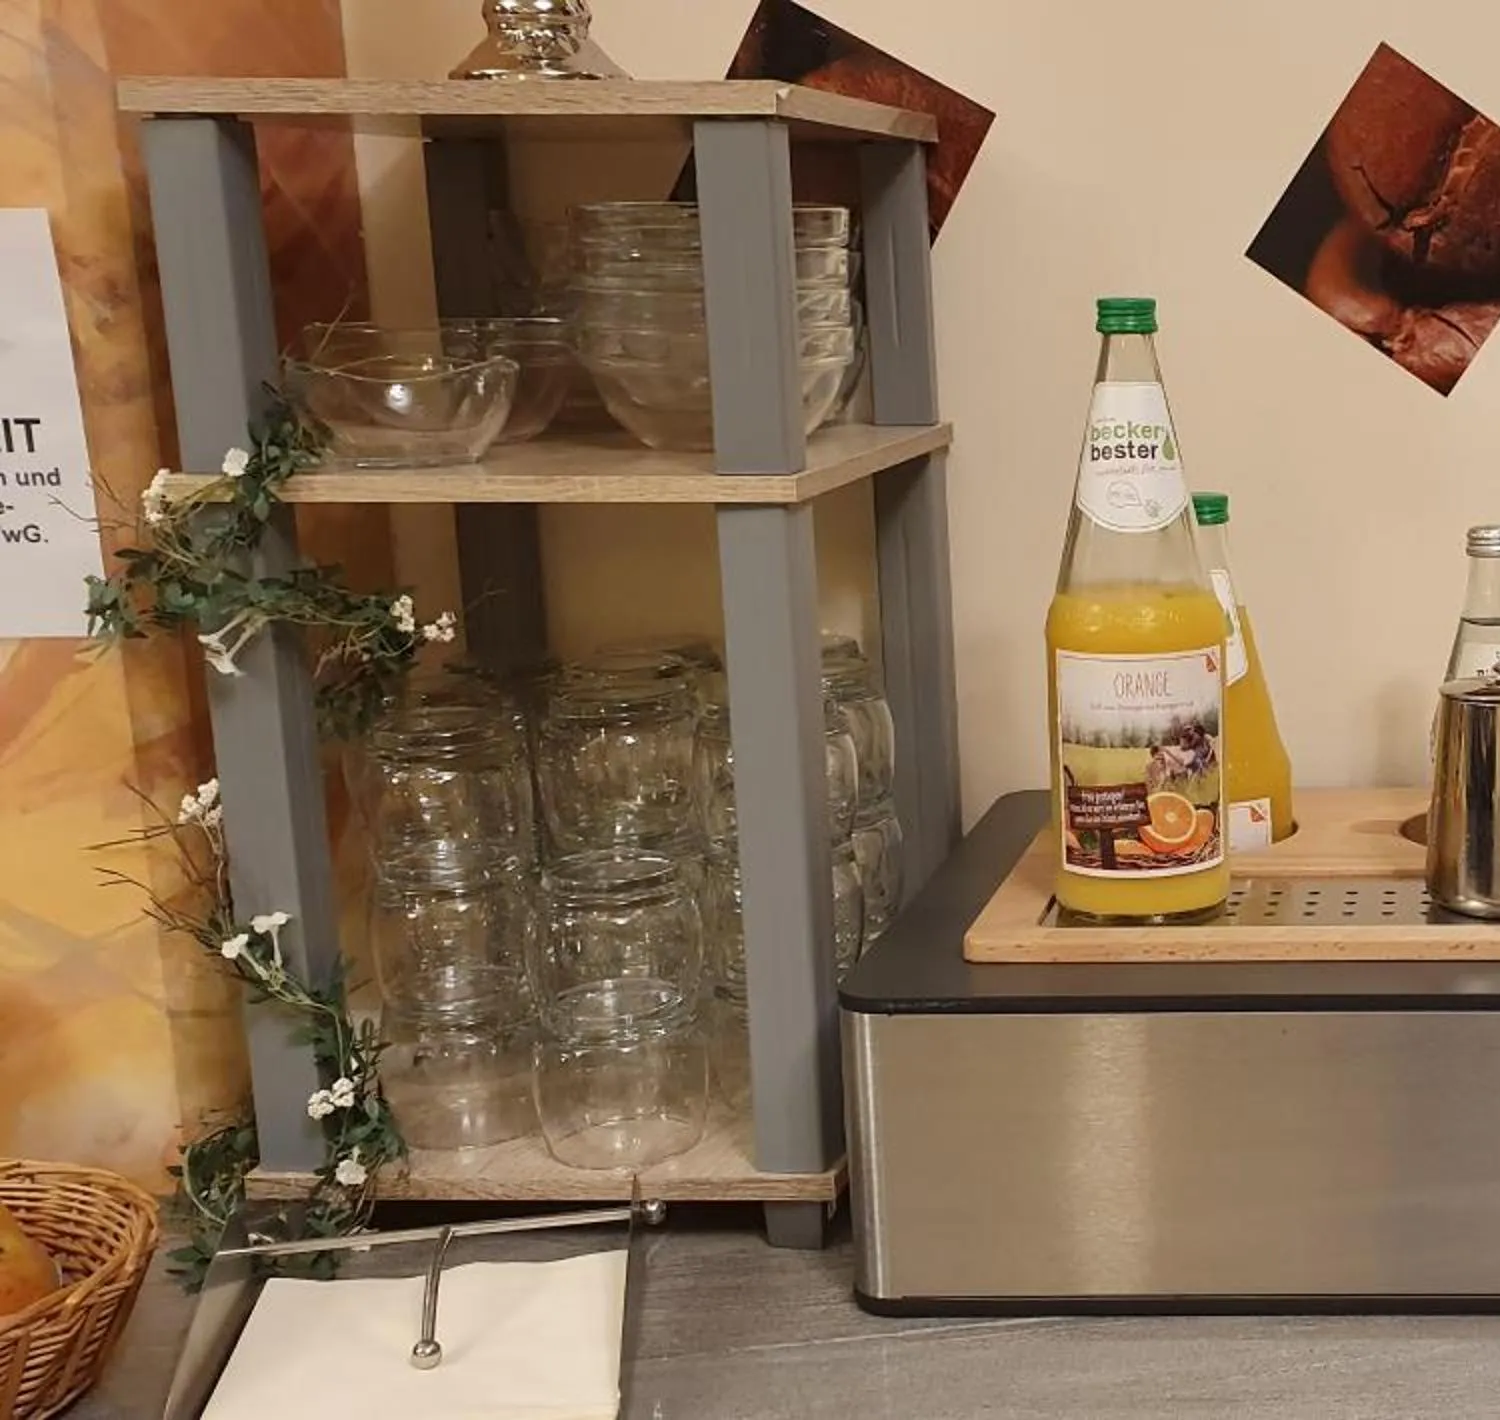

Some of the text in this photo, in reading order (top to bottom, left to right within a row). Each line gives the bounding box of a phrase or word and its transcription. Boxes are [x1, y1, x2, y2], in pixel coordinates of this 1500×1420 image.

[0, 417, 41, 453] IT
[1090, 440, 1159, 462] bester
[15, 467, 62, 487] und
[1, 523, 50, 544] wG.
[1113, 669, 1173, 699] ORANGE
